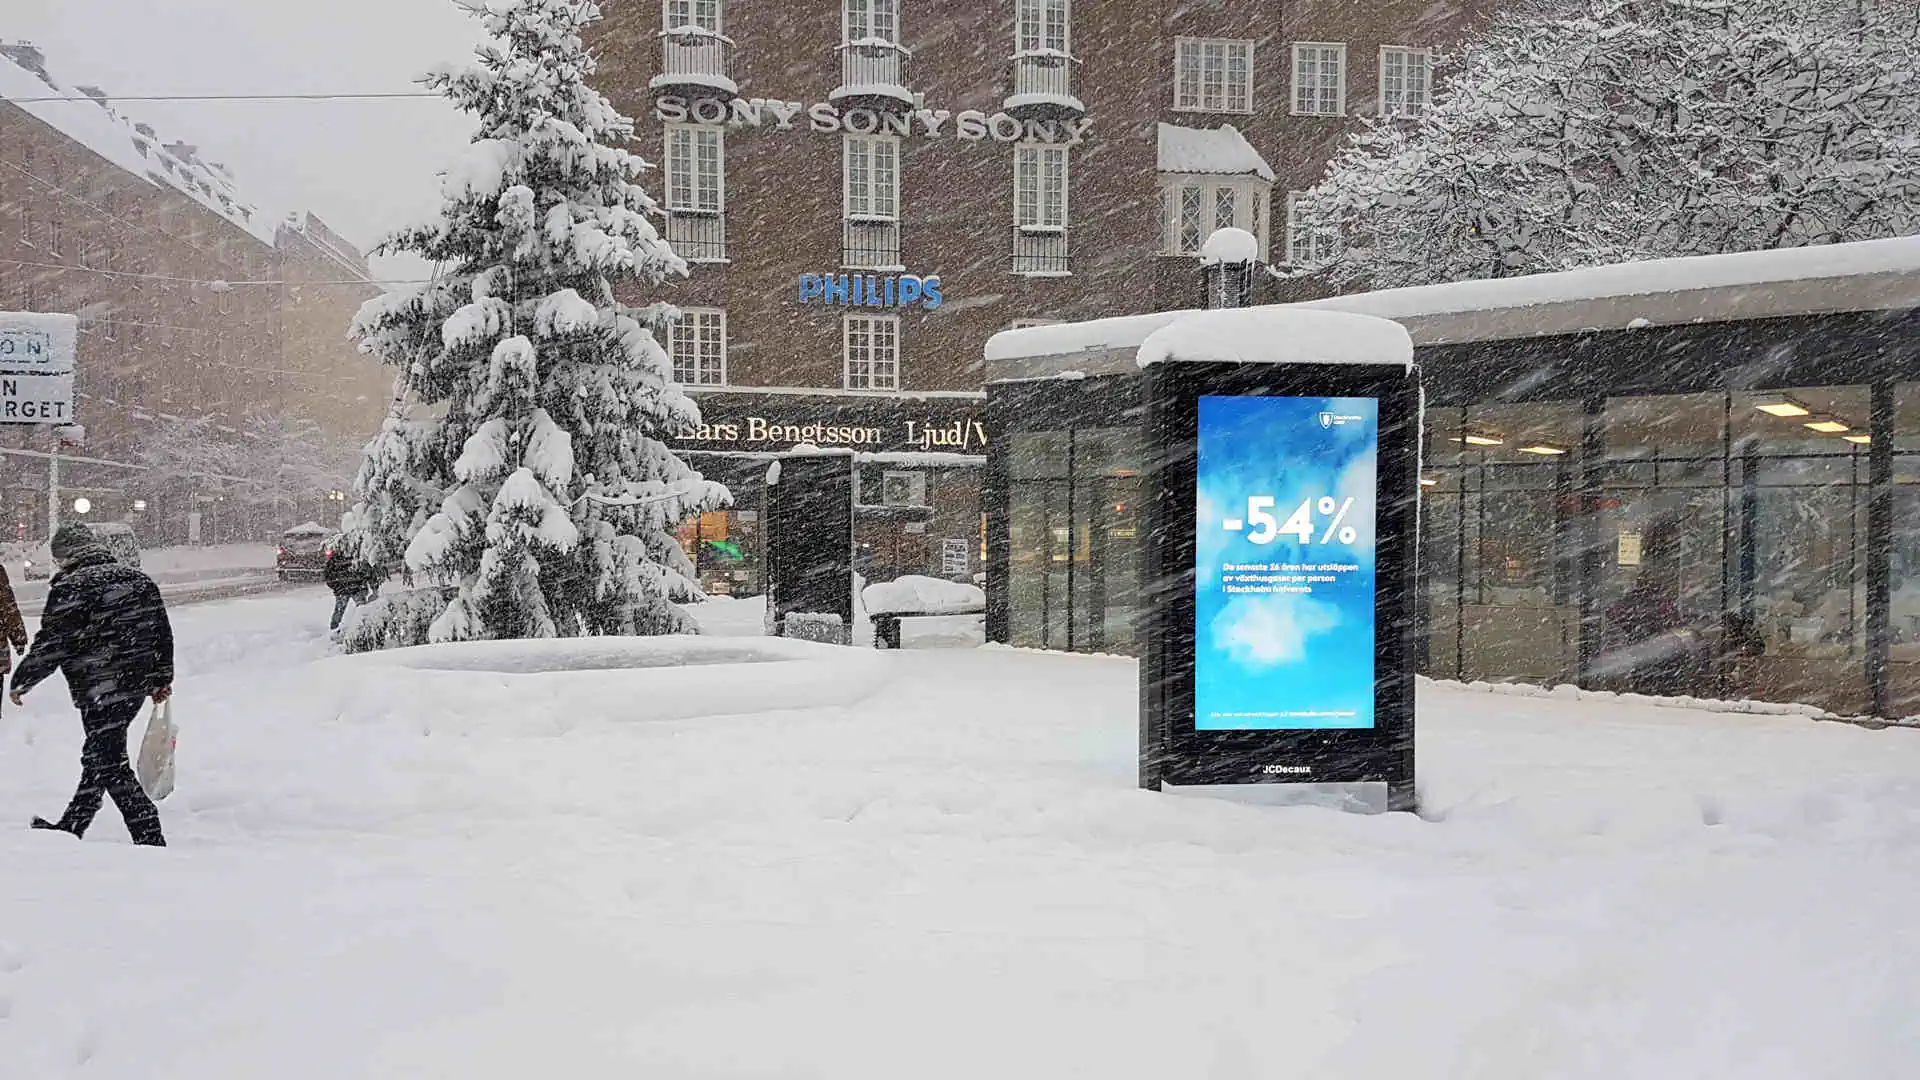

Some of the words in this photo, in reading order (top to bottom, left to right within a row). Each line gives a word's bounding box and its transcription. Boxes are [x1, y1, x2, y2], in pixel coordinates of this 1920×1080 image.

[655, 95, 801, 129] SONY
[808, 102, 950, 137] SONY
[957, 109, 1094, 145] SONY
[798, 272, 943, 310] PHILIPS
[747, 417, 881, 445] Bengtsson
[1222, 495, 1357, 545] -54%
[1223, 562, 1234, 571] De
[1236, 562, 1268, 571] senaste
[1262, 764, 1311, 774] JCDecaux
